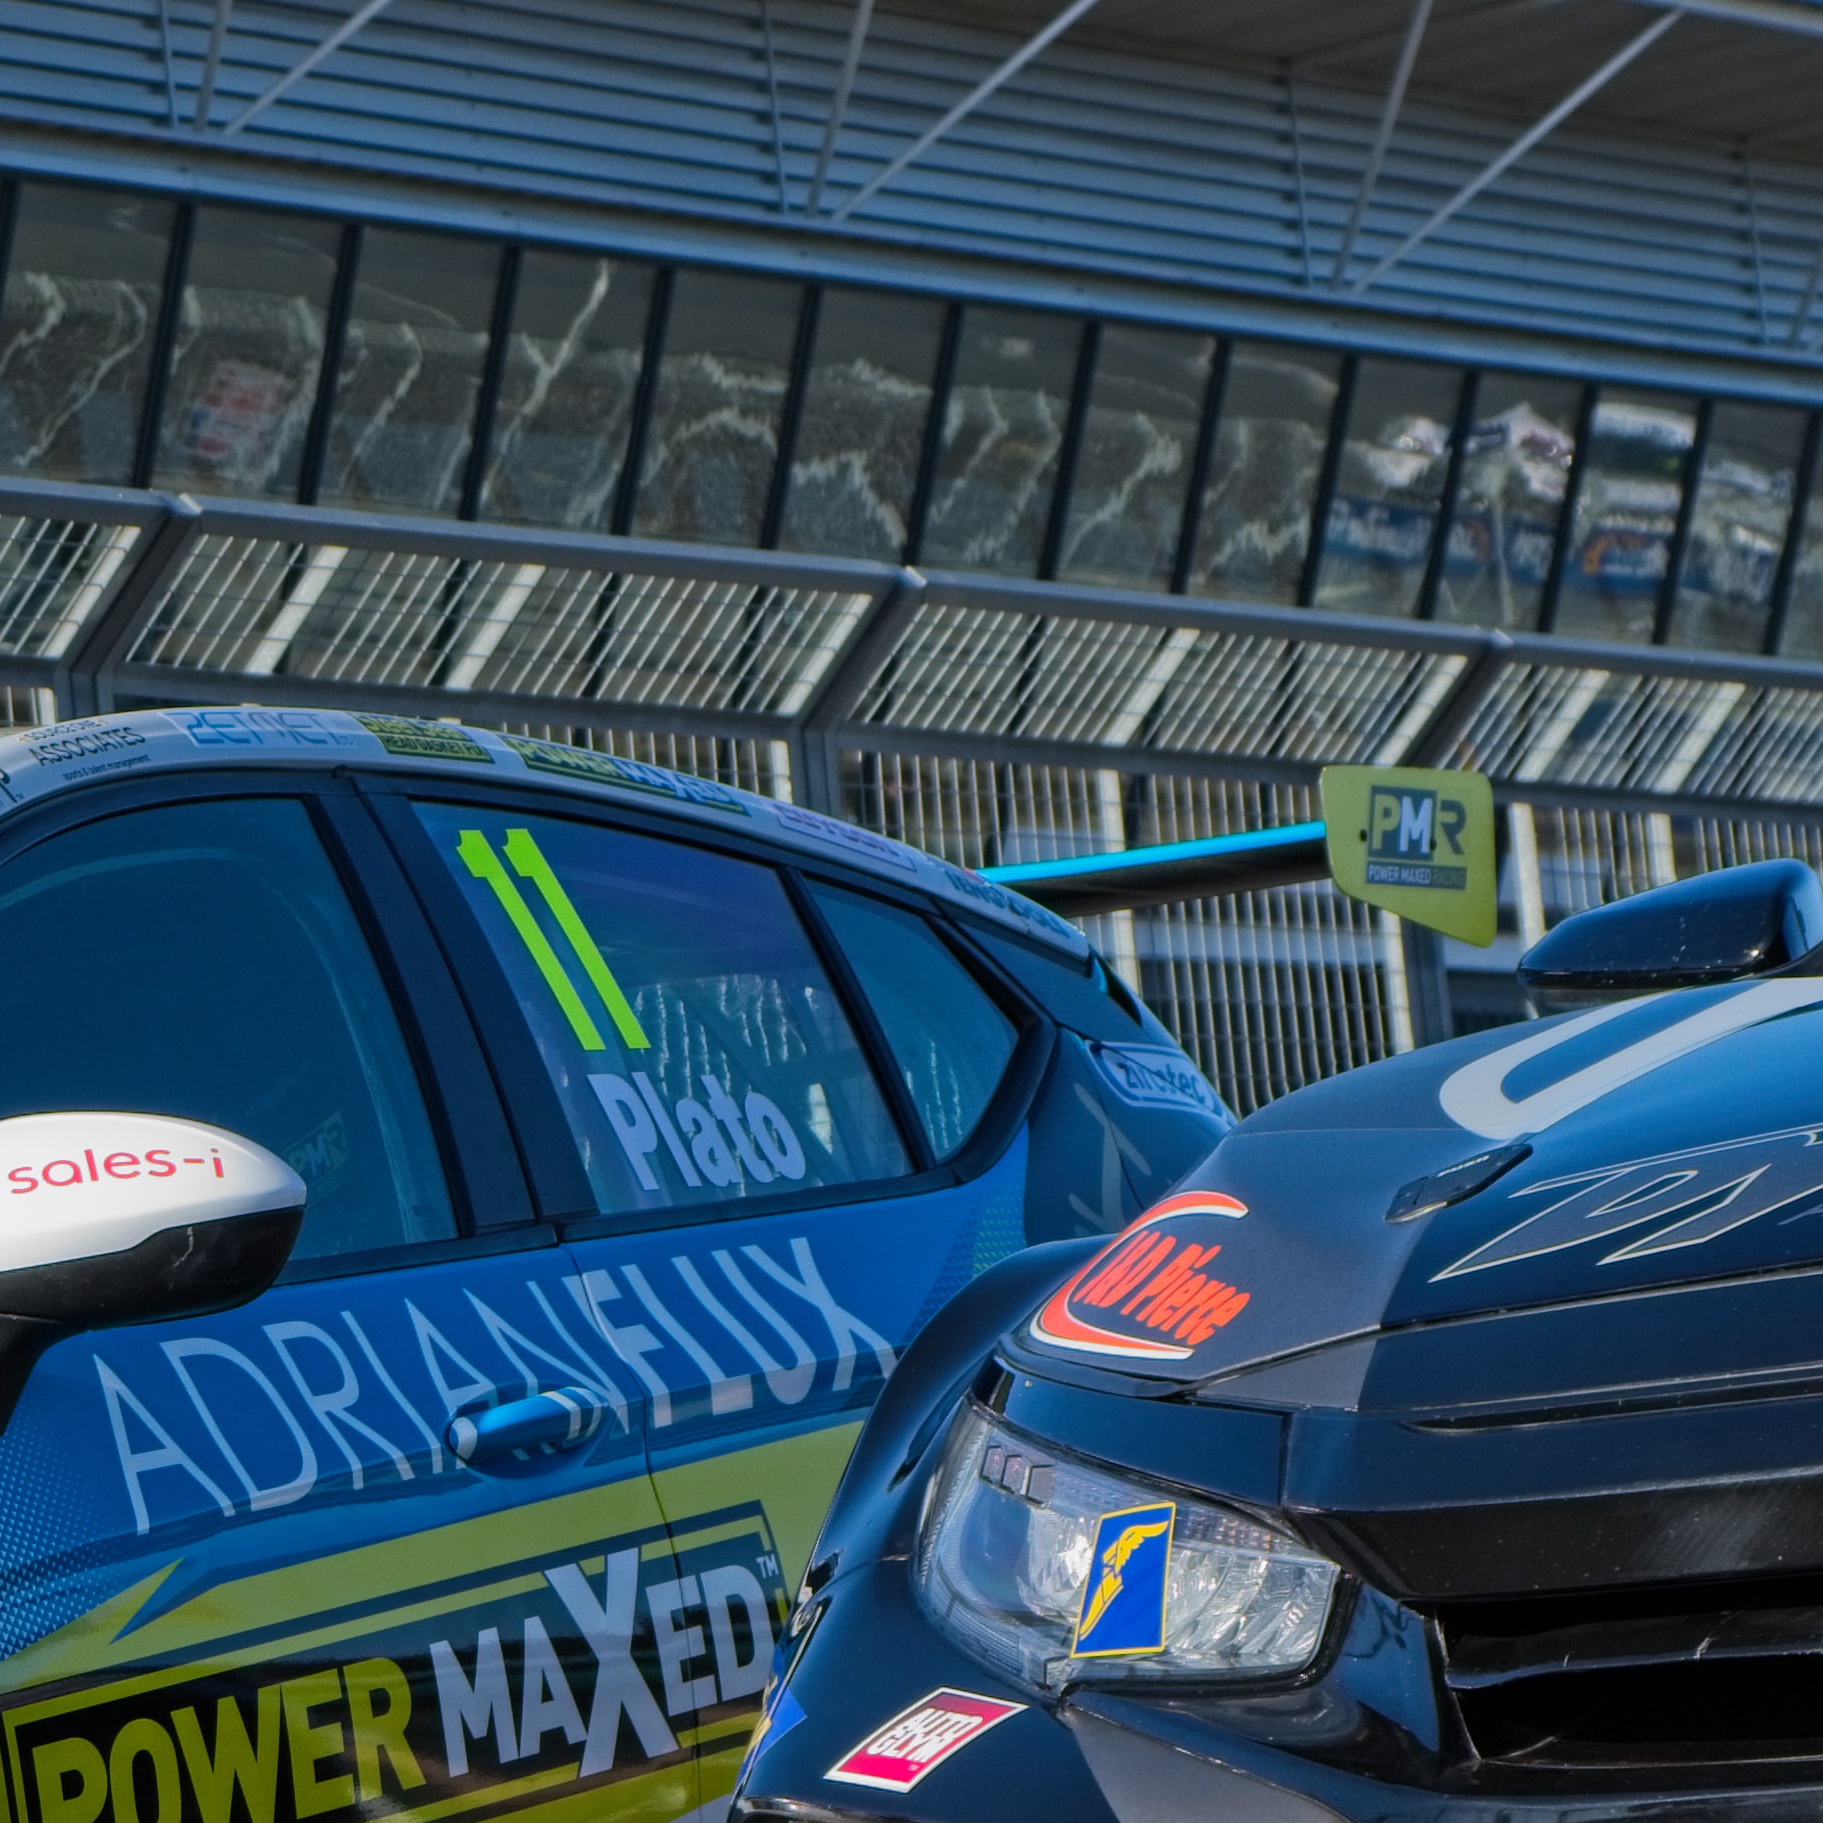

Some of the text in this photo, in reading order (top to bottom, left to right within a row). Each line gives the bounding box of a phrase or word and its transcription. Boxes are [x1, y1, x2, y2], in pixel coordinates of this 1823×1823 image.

[28, 727, 146, 766] ASSOCIATES
[1372, 793, 1468, 856] PMR
[1368, 863, 1400, 883] POWER
[1400, 867, 1431, 885] MAXED
[455, 828, 651, 1050] 11
[587, 1072, 806, 1191] Plato
[8, 1148, 225, 1195] sales-i
[1120, 1243, 1251, 1346] Pierce
[428, 1547, 774, 1781] MAXED
[865, 1729, 948, 1764] GLYM
[905, 1706, 984, 1741] AUTO
